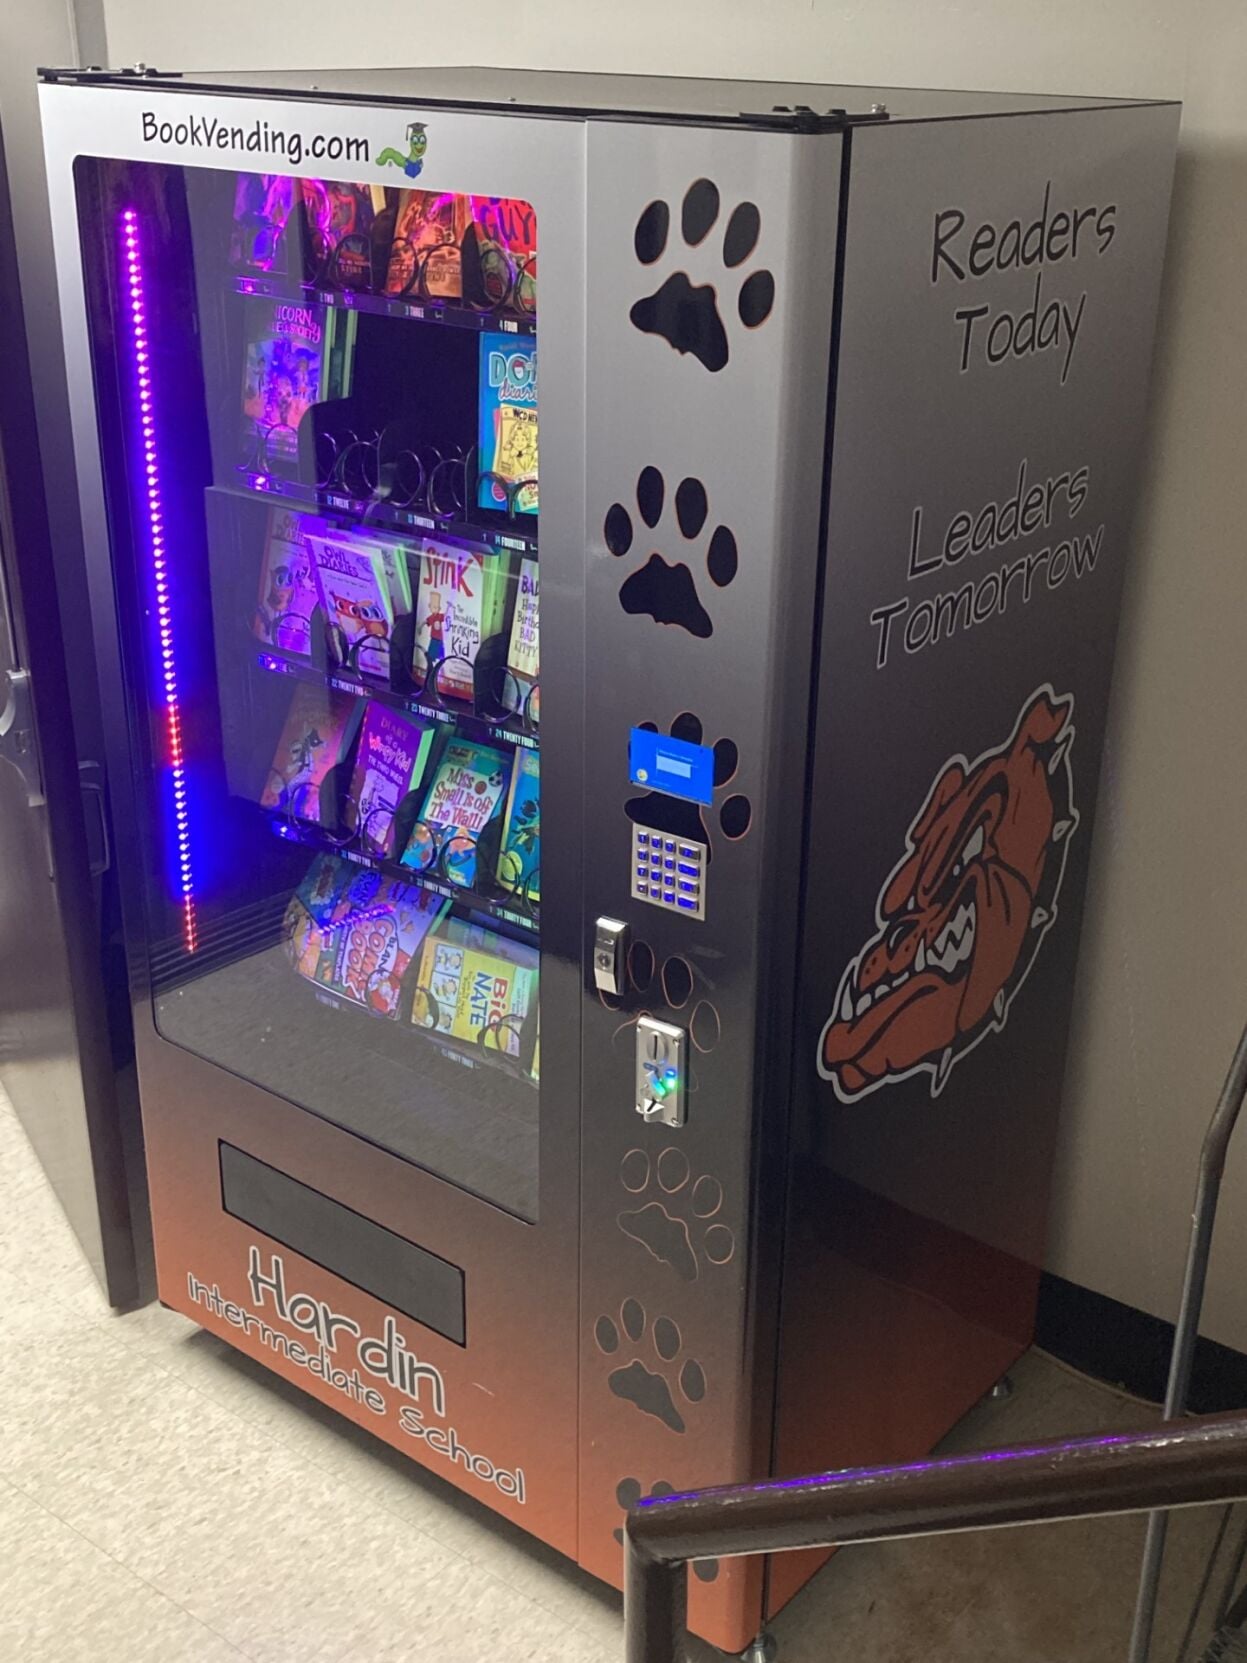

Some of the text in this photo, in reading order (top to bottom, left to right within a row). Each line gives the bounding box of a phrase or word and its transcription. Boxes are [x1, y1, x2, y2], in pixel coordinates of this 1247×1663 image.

[142, 112, 369, 164] BookVending.com
[931, 180, 1117, 284] Readers
[954, 271, 1087, 386] Today
[907, 457, 1089, 581] Leaders
[870, 524, 1105, 670] Tomorrow
[451, 636, 470, 658] Kid
[447, 768, 474, 790] Miss
[503, 730, 521, 744] TWENTY
[521, 735, 534, 748] FOUR
[434, 781, 464, 806] Small
[474, 796, 493, 815] off
[469, 972, 493, 1029] NATE
[248, 1245, 445, 1417] Hardin
[187, 1272, 526, 1504] Intermediate School
